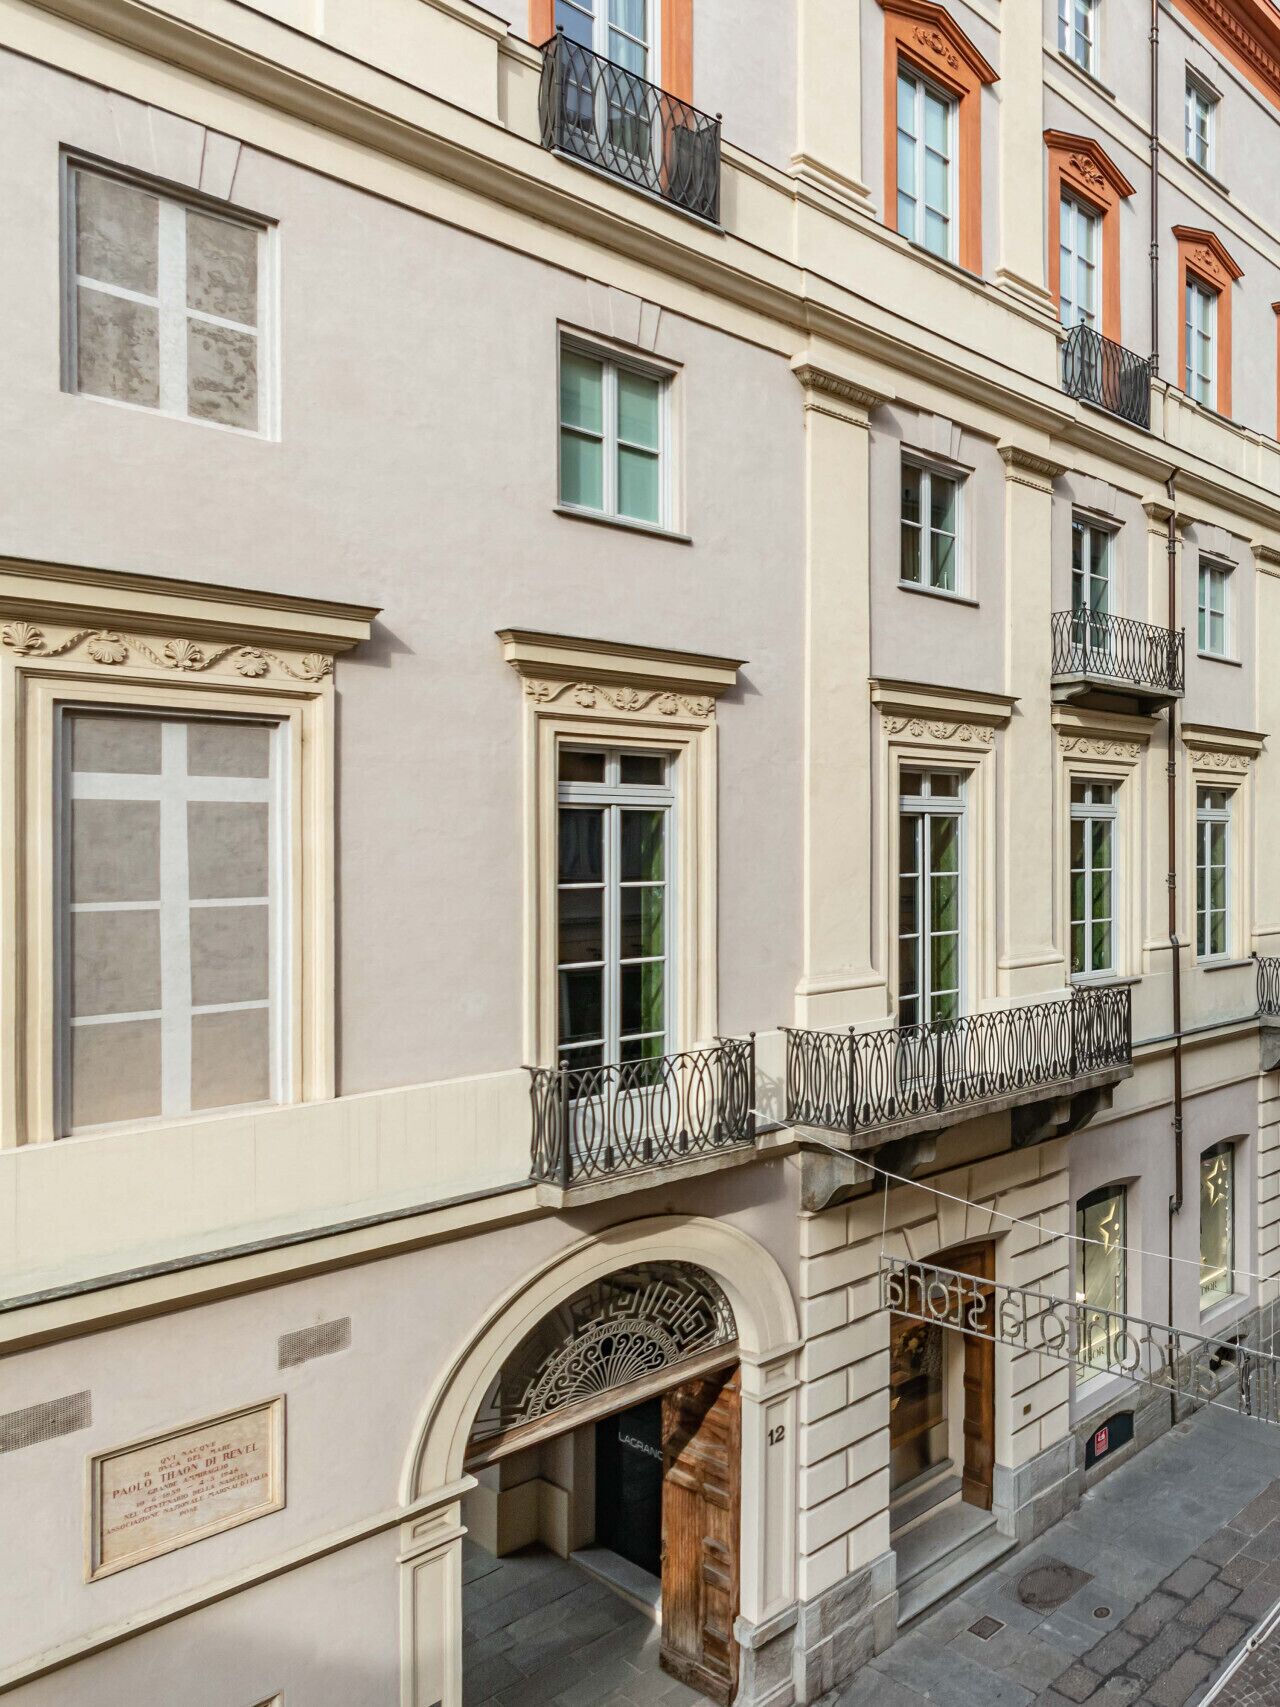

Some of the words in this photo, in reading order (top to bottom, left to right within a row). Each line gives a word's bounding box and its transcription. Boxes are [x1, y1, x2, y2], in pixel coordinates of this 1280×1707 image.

[768, 1425, 785, 1446] 12
[112, 1478, 151, 1498] PAOLO
[161, 1462, 197, 1482] THAON
[223, 1442, 257, 1461] REVEL
